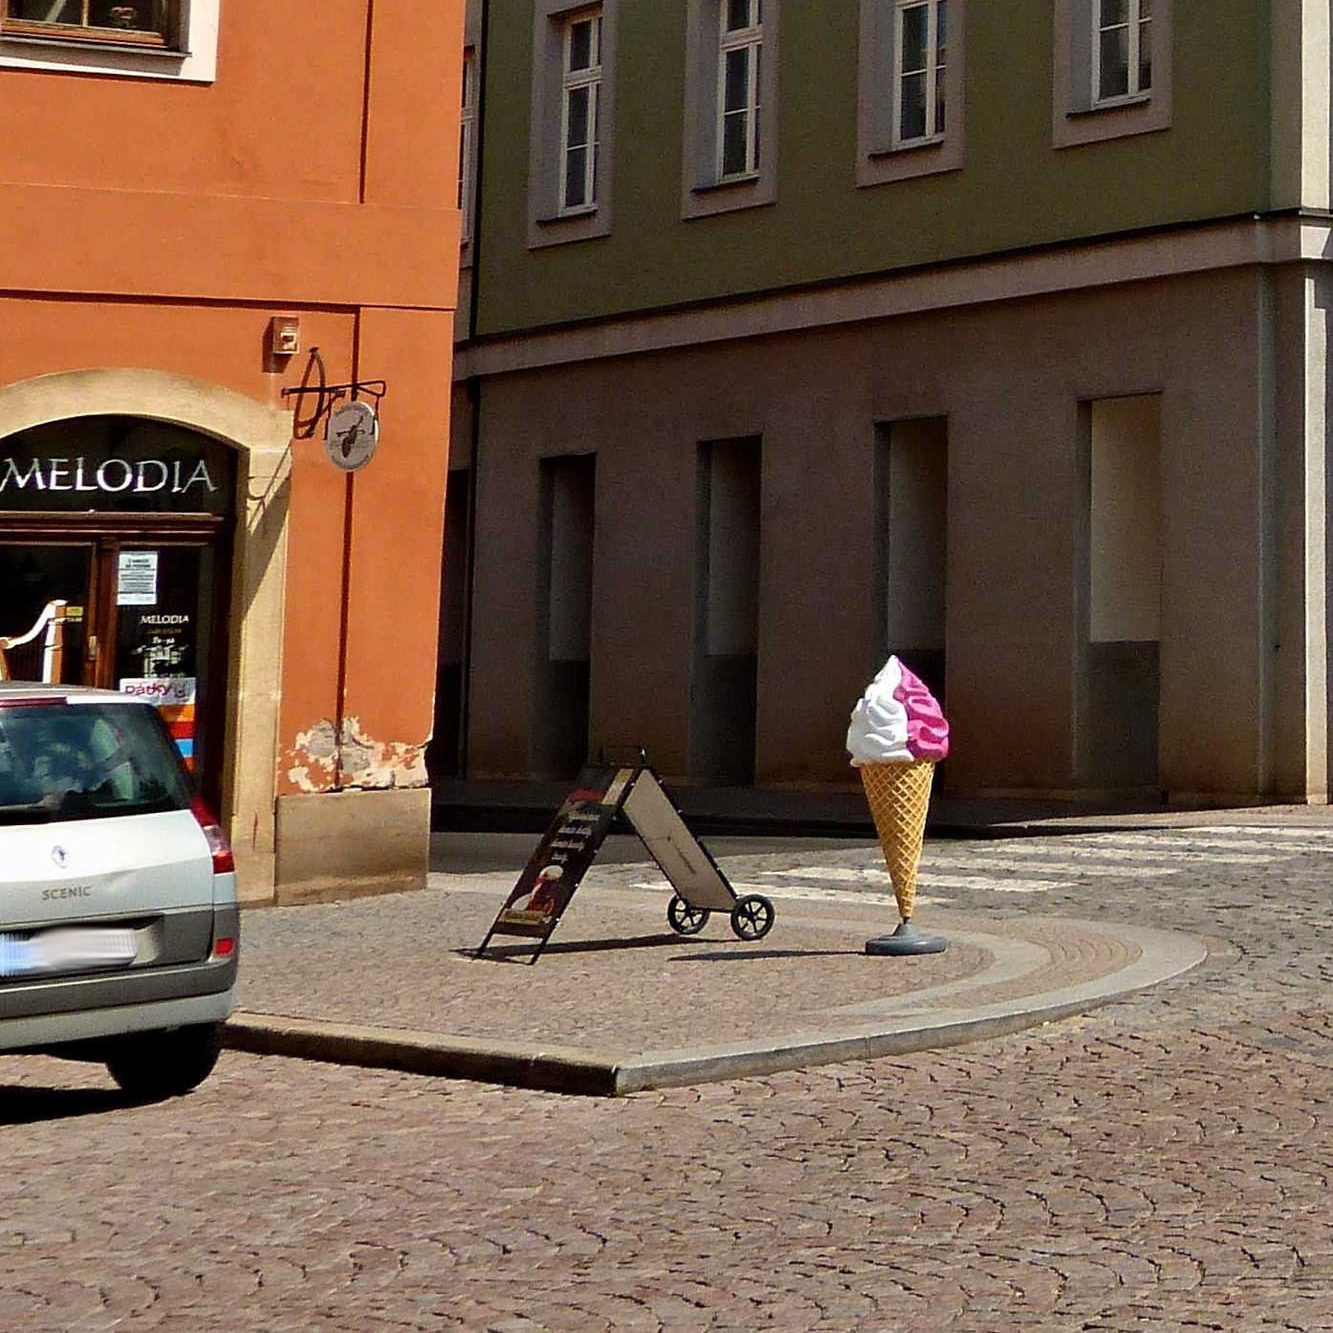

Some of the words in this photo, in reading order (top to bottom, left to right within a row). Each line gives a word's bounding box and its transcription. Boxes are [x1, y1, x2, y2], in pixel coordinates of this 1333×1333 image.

[0, 456, 217, 493] MELODIA
[140, 614, 190, 625] MELODIA
[41, 885, 93, 901] SCENIC
